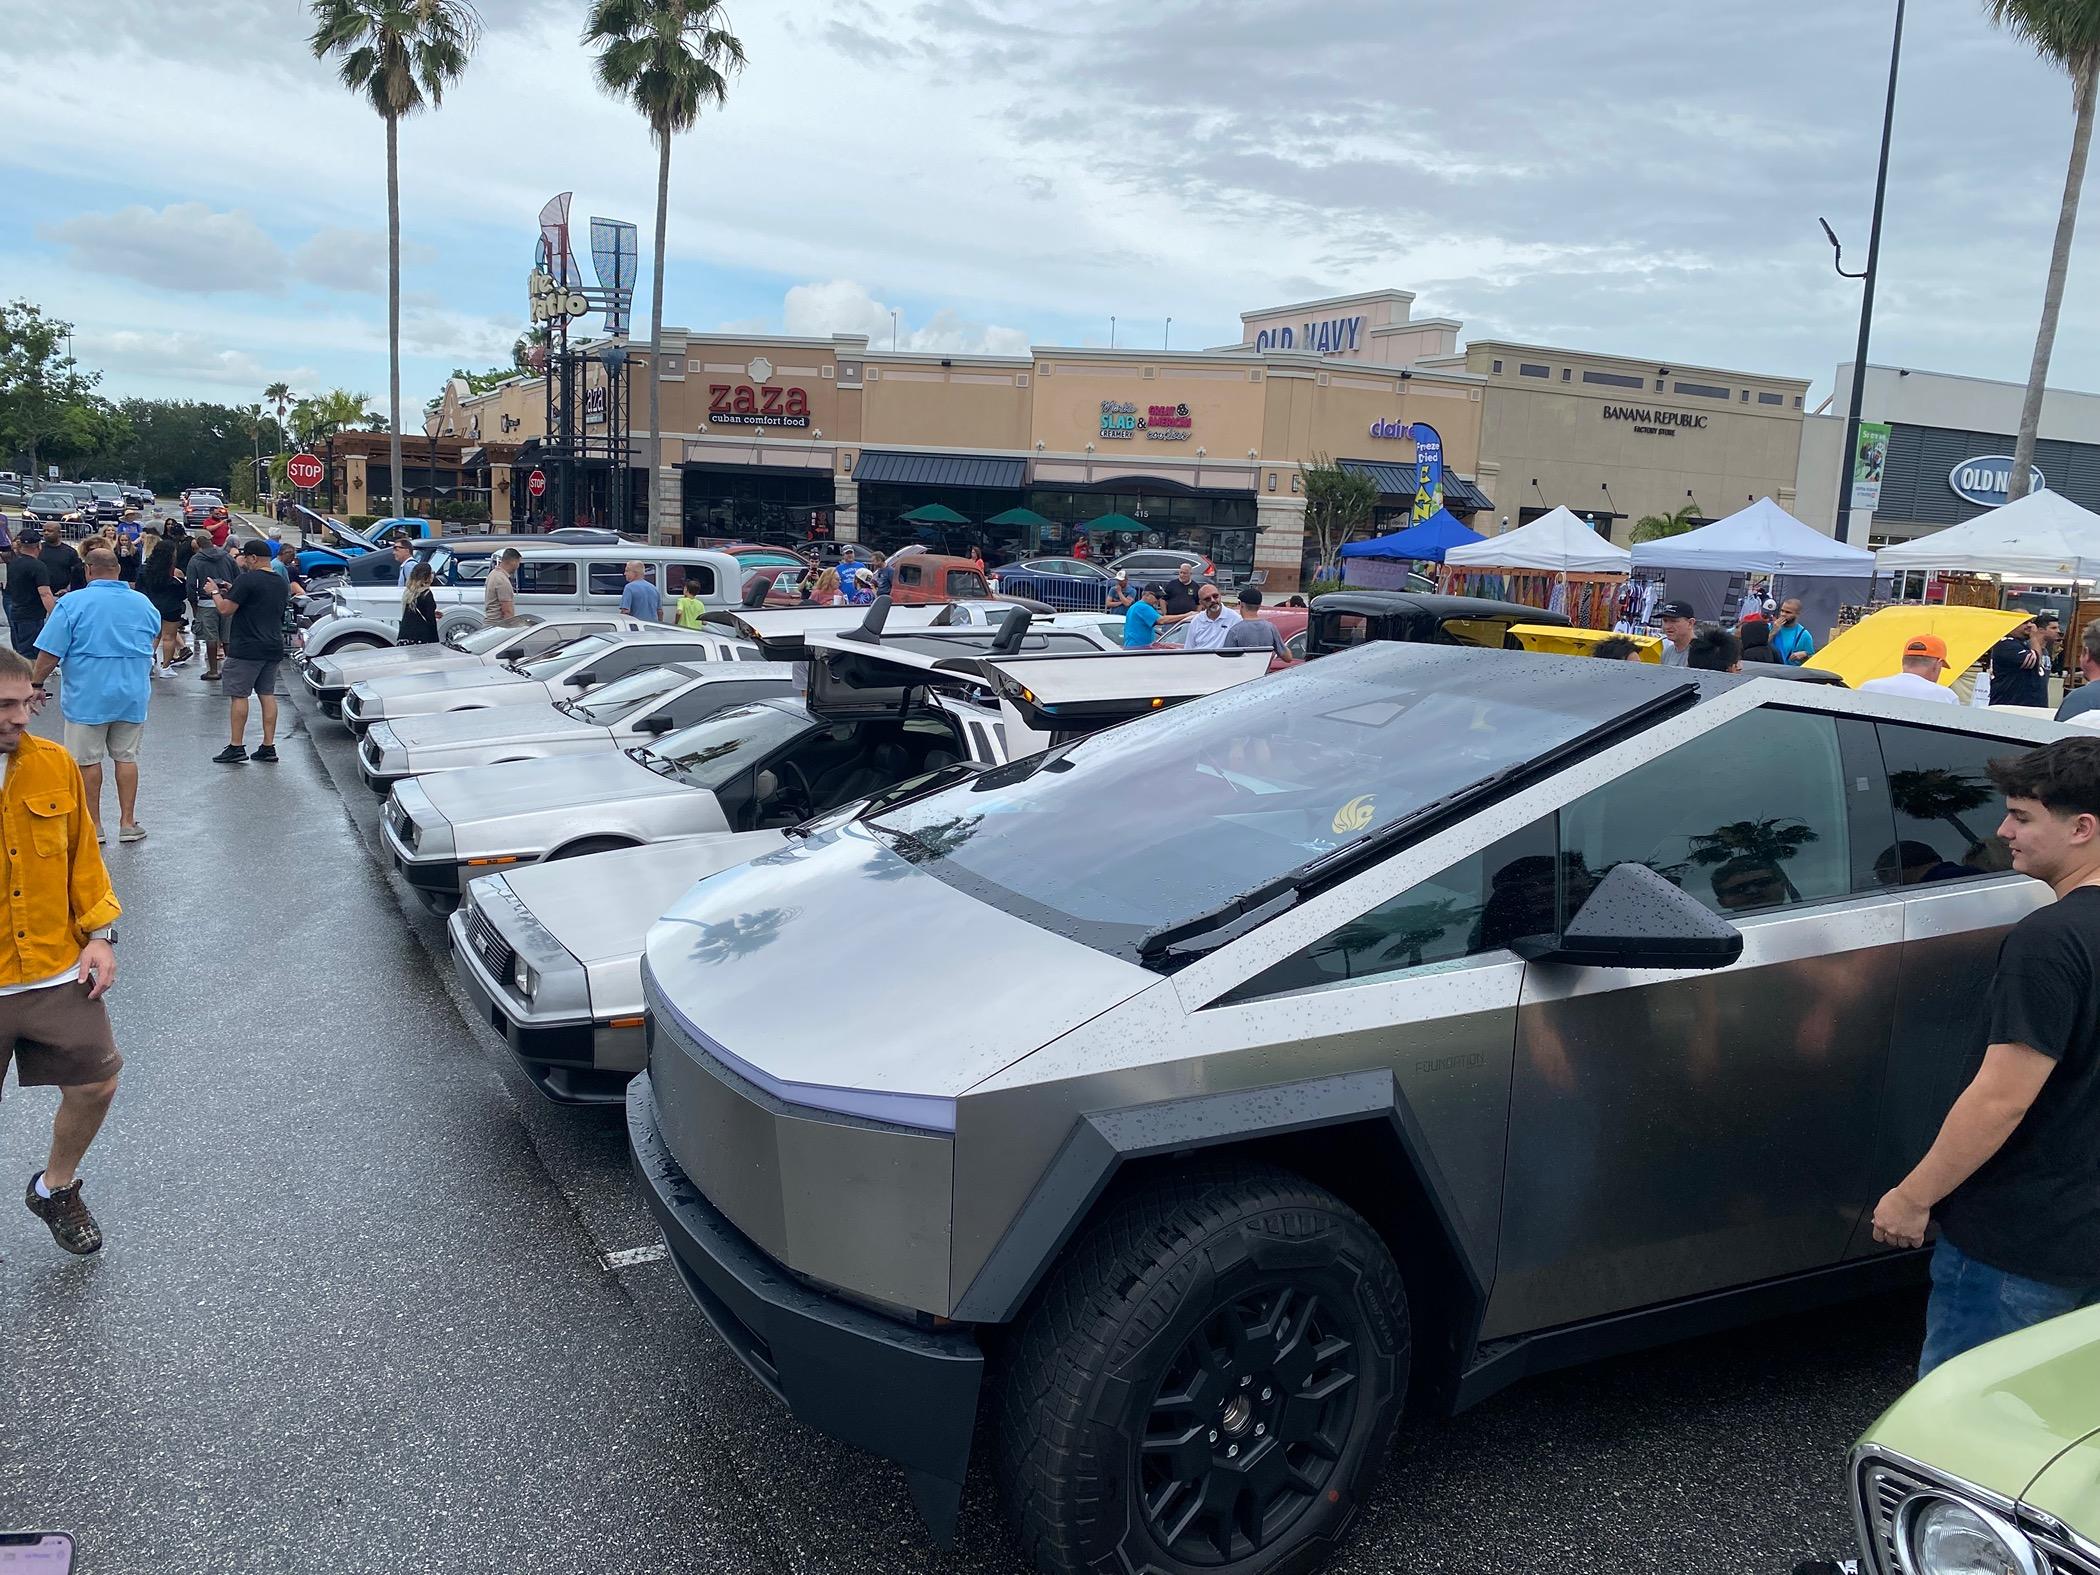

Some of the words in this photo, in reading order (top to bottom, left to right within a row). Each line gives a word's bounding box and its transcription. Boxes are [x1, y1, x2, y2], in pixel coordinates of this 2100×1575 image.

[1303, 316, 1362, 353] NAVY
[586, 386, 604, 413] aza
[711, 414, 741, 424] cuban
[743, 415, 781, 425] comfort
[783, 416, 805, 427] food
[1101, 415, 1135, 430] SLAB
[1603, 405, 1652, 424] BANANA
[1654, 411, 1708, 429] REPUBLIC
[1633, 425, 1658, 435] FACTORY
[1658, 428, 1675, 436] STORE
[290, 463, 322, 478] STOP
[530, 478, 545, 488] STOP
[1960, 467, 1993, 492] OLD
[1994, 470, 2040, 496] NY
[1134, 510, 1149, 518] 415
